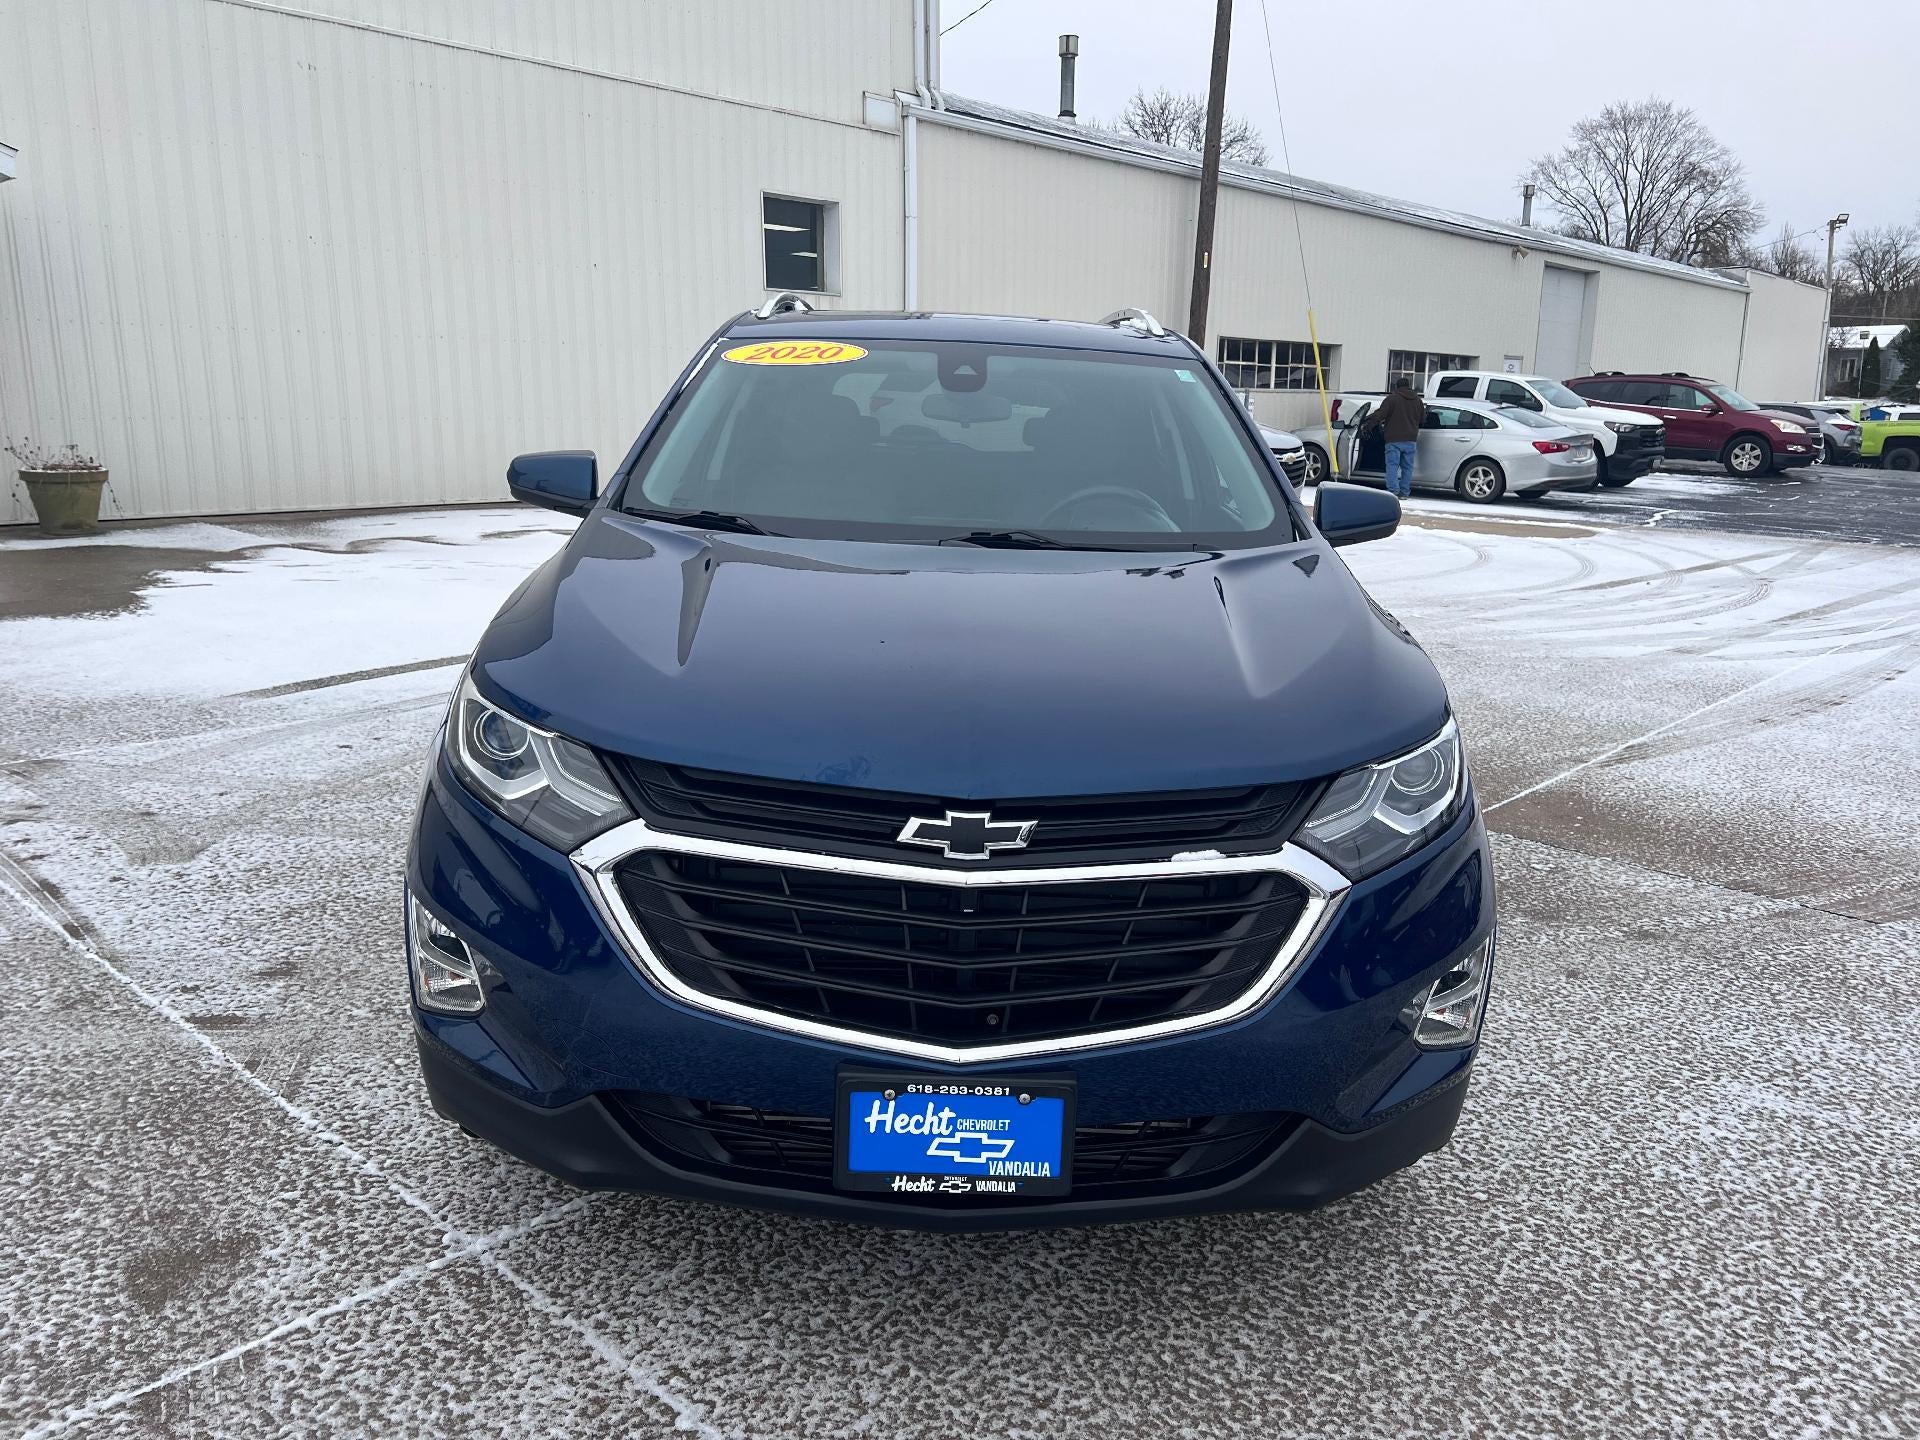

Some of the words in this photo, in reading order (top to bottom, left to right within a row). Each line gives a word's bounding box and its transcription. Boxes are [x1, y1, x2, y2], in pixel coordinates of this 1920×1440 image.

[744, 346, 844, 361] 2020
[907, 1084, 1010, 1096] 618-283-0381
[864, 1099, 957, 1136] Hecht
[957, 1118, 1011, 1131] CHEVROLET
[988, 1160, 1051, 1178] VANDALIA
[891, 1175, 936, 1193] Hecht
[975, 1180, 1016, 1193] VANDALIA
